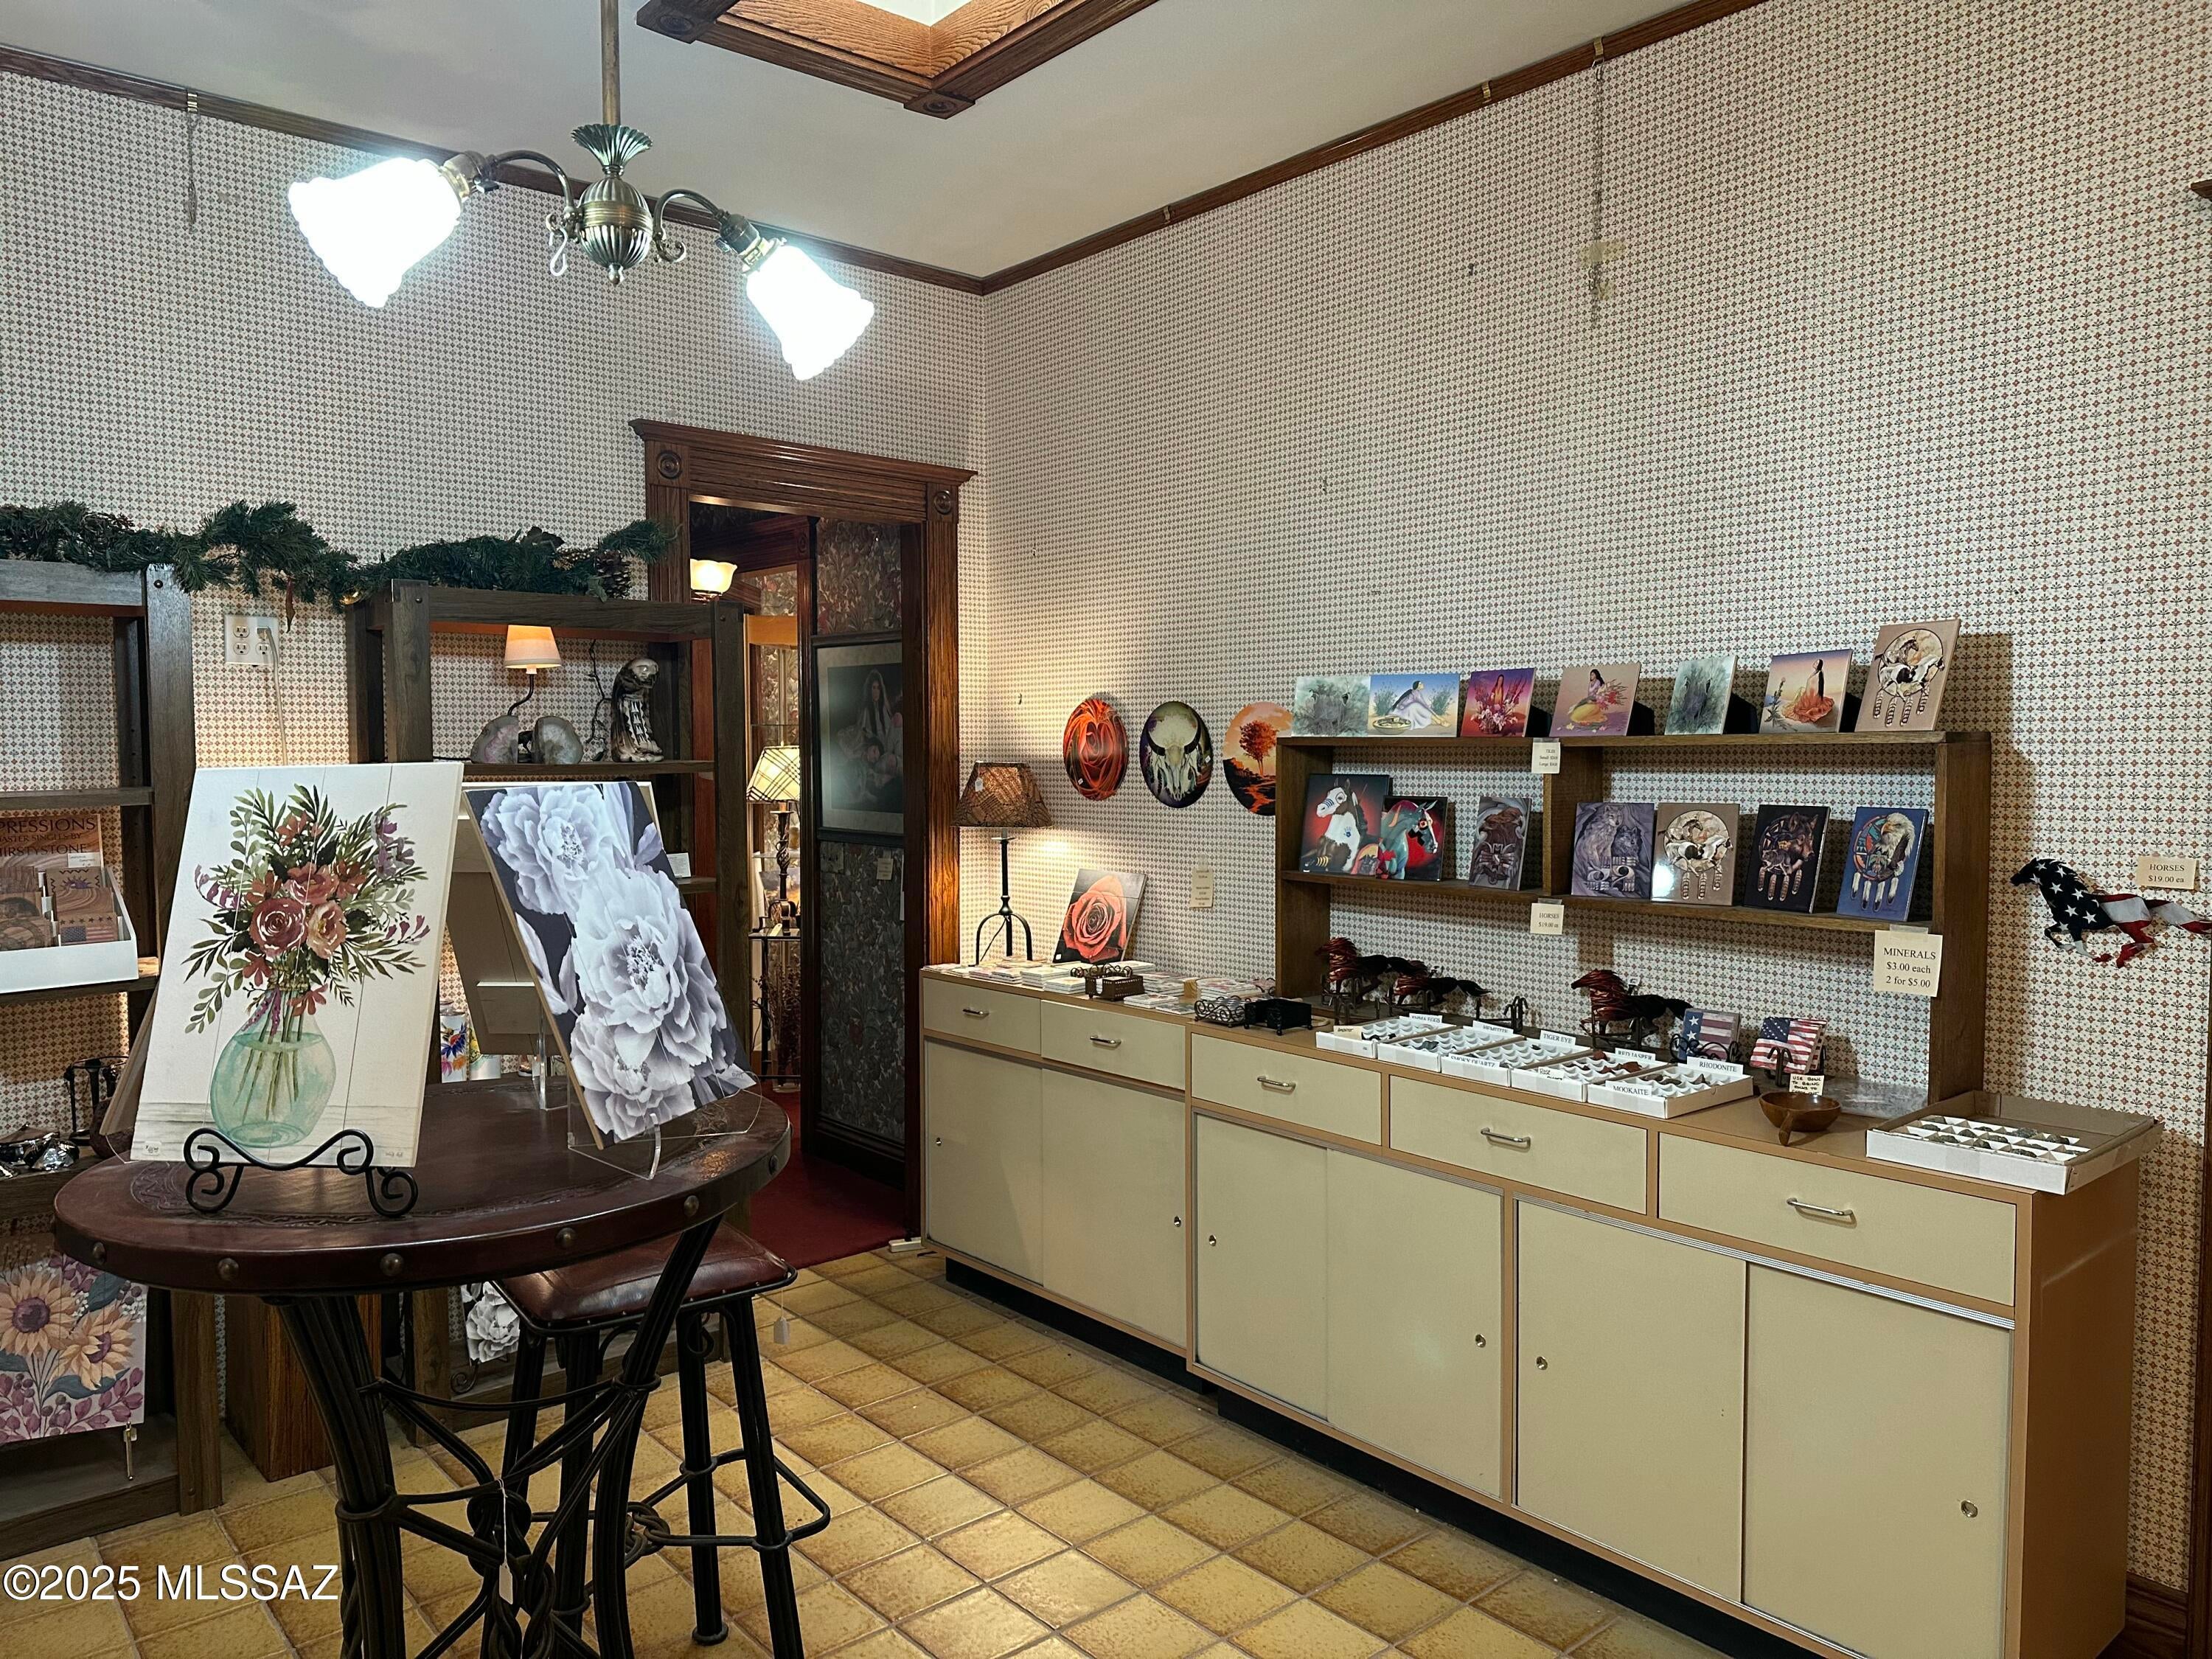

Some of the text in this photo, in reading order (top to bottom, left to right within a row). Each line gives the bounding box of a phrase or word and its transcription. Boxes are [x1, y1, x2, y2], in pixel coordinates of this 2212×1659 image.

[0, 834, 29, 843] ASTER
[2149, 863, 2185, 872] HORSES
[2148, 874, 2174, 883] $19.00
[1884, 947, 1935, 959] MINERALS
[1886, 961, 1931, 974] $3.00 each
[1885, 975, 1930, 988] 2 for $5.00
[1543, 1033, 1572, 1044] TIGER EYE
[1631, 1052, 1652, 1060] JASPER
[1699, 1061, 1737, 1072] RHODONITE
[1613, 1085, 1649, 1096] MOOKAITE
